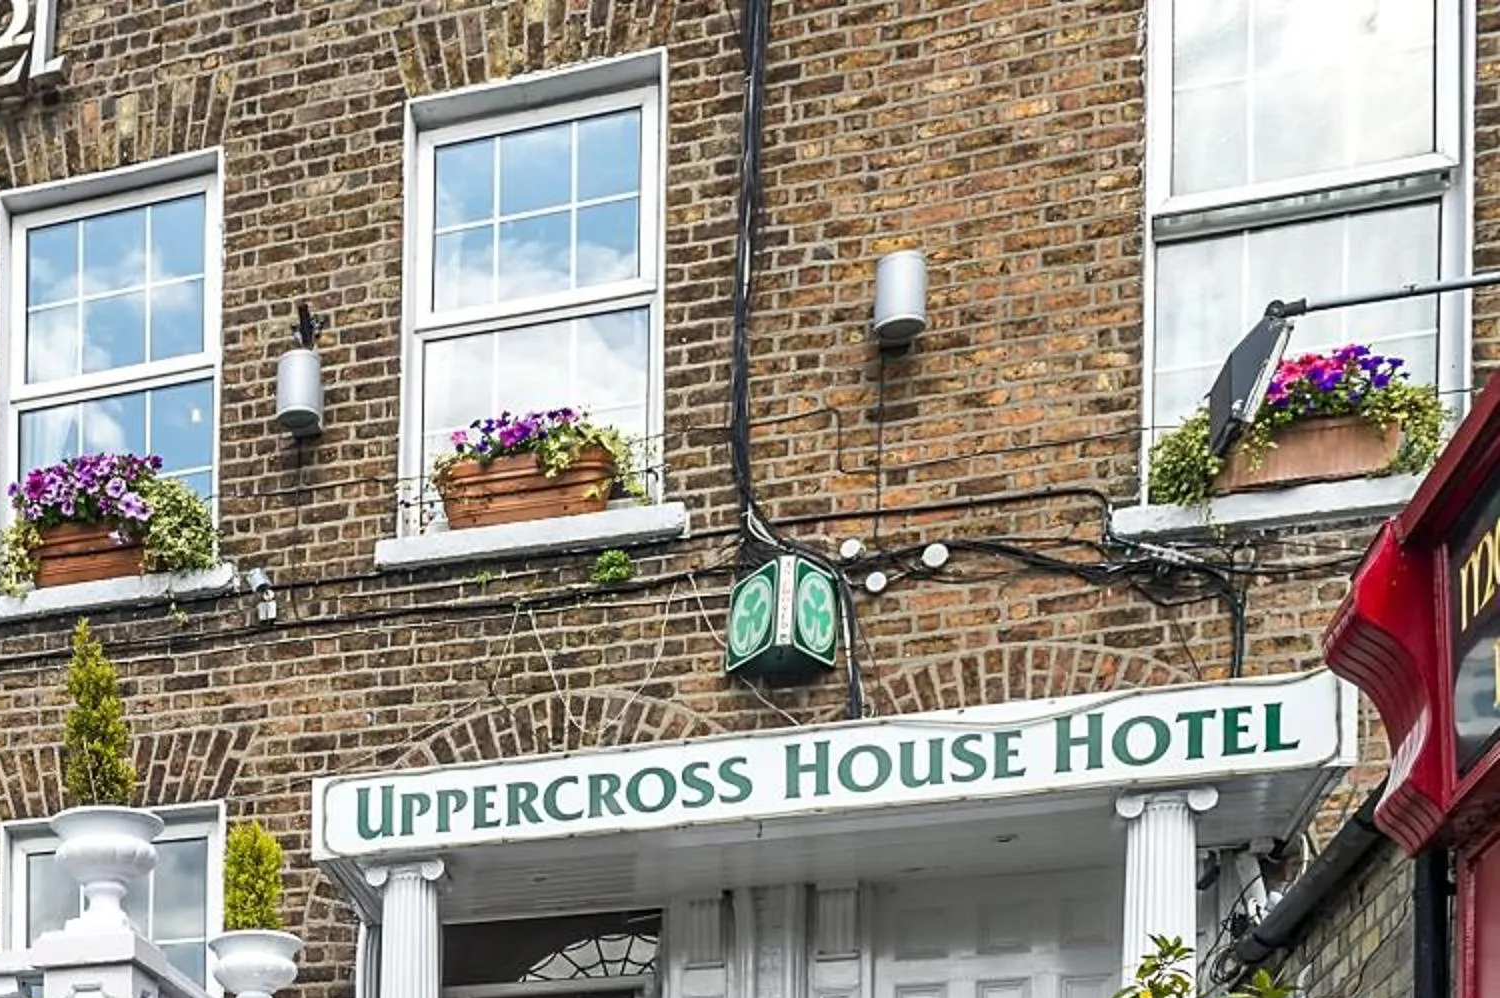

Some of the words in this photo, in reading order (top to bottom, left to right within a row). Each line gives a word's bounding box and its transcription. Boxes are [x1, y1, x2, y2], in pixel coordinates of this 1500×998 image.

[355, 756, 754, 841] UPPERCROSS
[784, 729, 1027, 799] HOUSE
[1053, 701, 1301, 774] HOTEL
